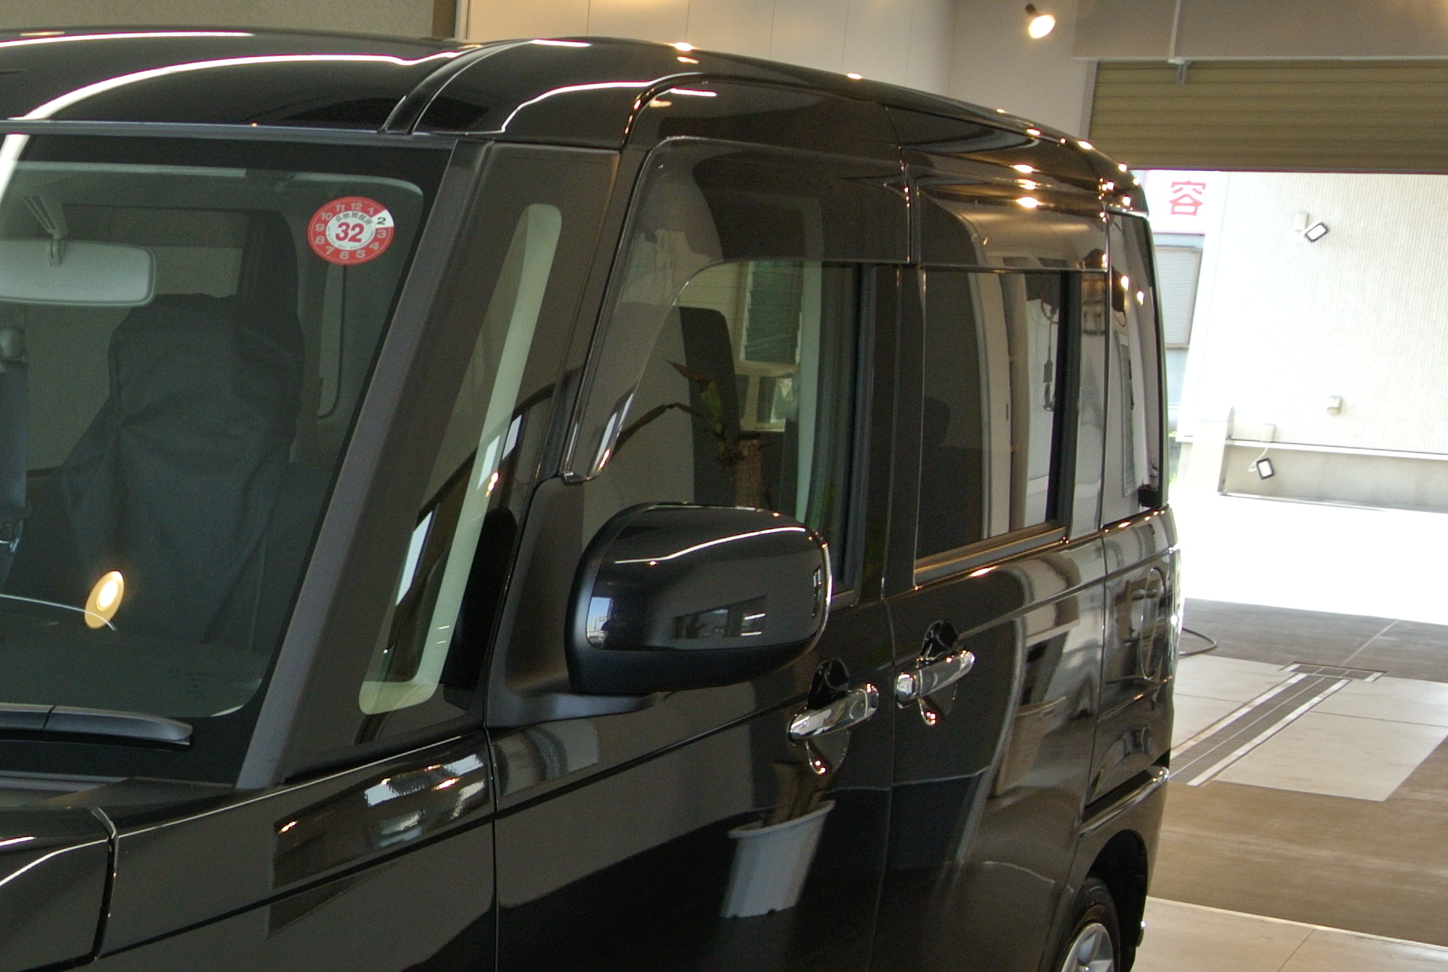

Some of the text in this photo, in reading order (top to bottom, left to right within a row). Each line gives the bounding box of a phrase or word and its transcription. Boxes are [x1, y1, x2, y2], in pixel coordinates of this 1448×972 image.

[1169, 180, 1207, 216] 容
[336, 204, 346, 212] 11
[350, 202, 362, 210] 12
[368, 207, 374, 215] 1
[321, 212, 332, 220] 10
[376, 217, 386, 225] 2
[315, 223, 325, 232] 9
[335, 222, 364, 243] 32
[376, 229, 387, 238] 3
[315, 236, 325, 244] 8
[325, 246, 335, 254] 7
[369, 242, 380, 250] 4
[340, 251, 349, 259] 6
[356, 250, 366, 258] 5
